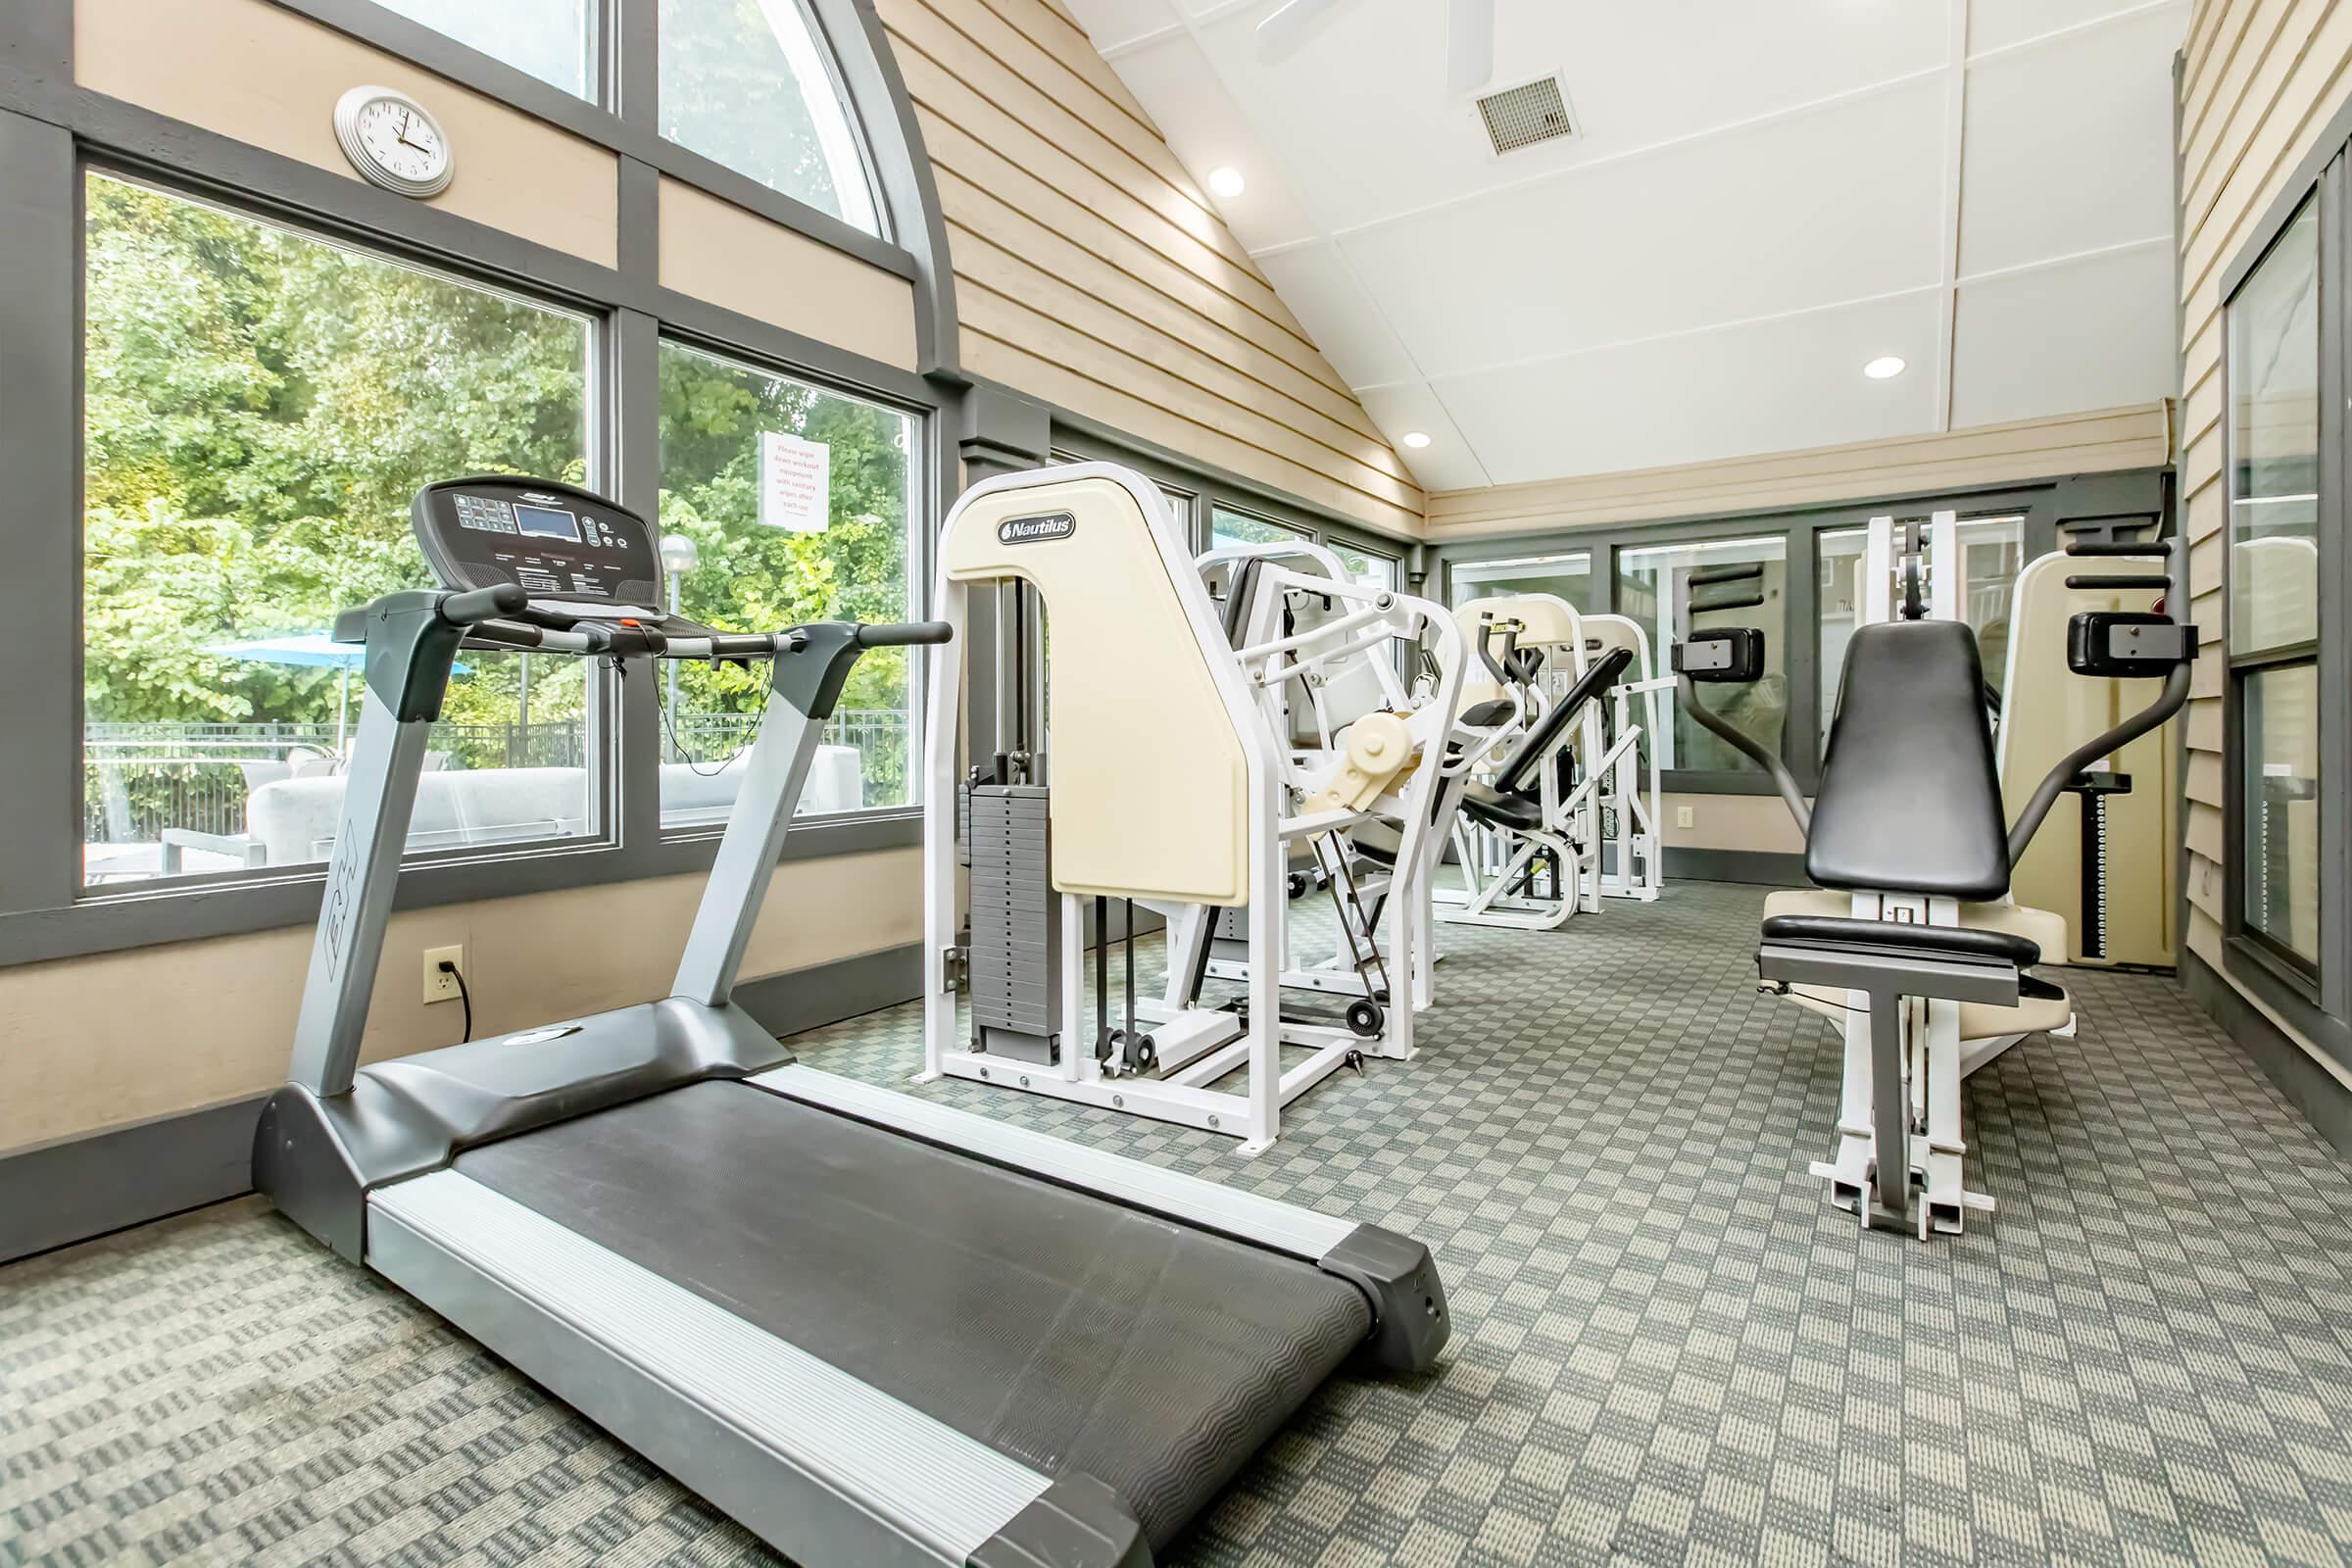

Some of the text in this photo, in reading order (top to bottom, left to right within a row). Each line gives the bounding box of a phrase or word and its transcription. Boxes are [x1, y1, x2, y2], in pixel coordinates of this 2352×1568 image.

[368, 107, 379, 119] 10
[382, 102, 391, 115] 11
[778, 445, 797, 455] Please
[774, 455, 819, 470] down workout
[779, 468, 812, 479] equipment
[792, 481, 815, 492] sanitary
[1011, 519, 1069, 537] Nautilus
